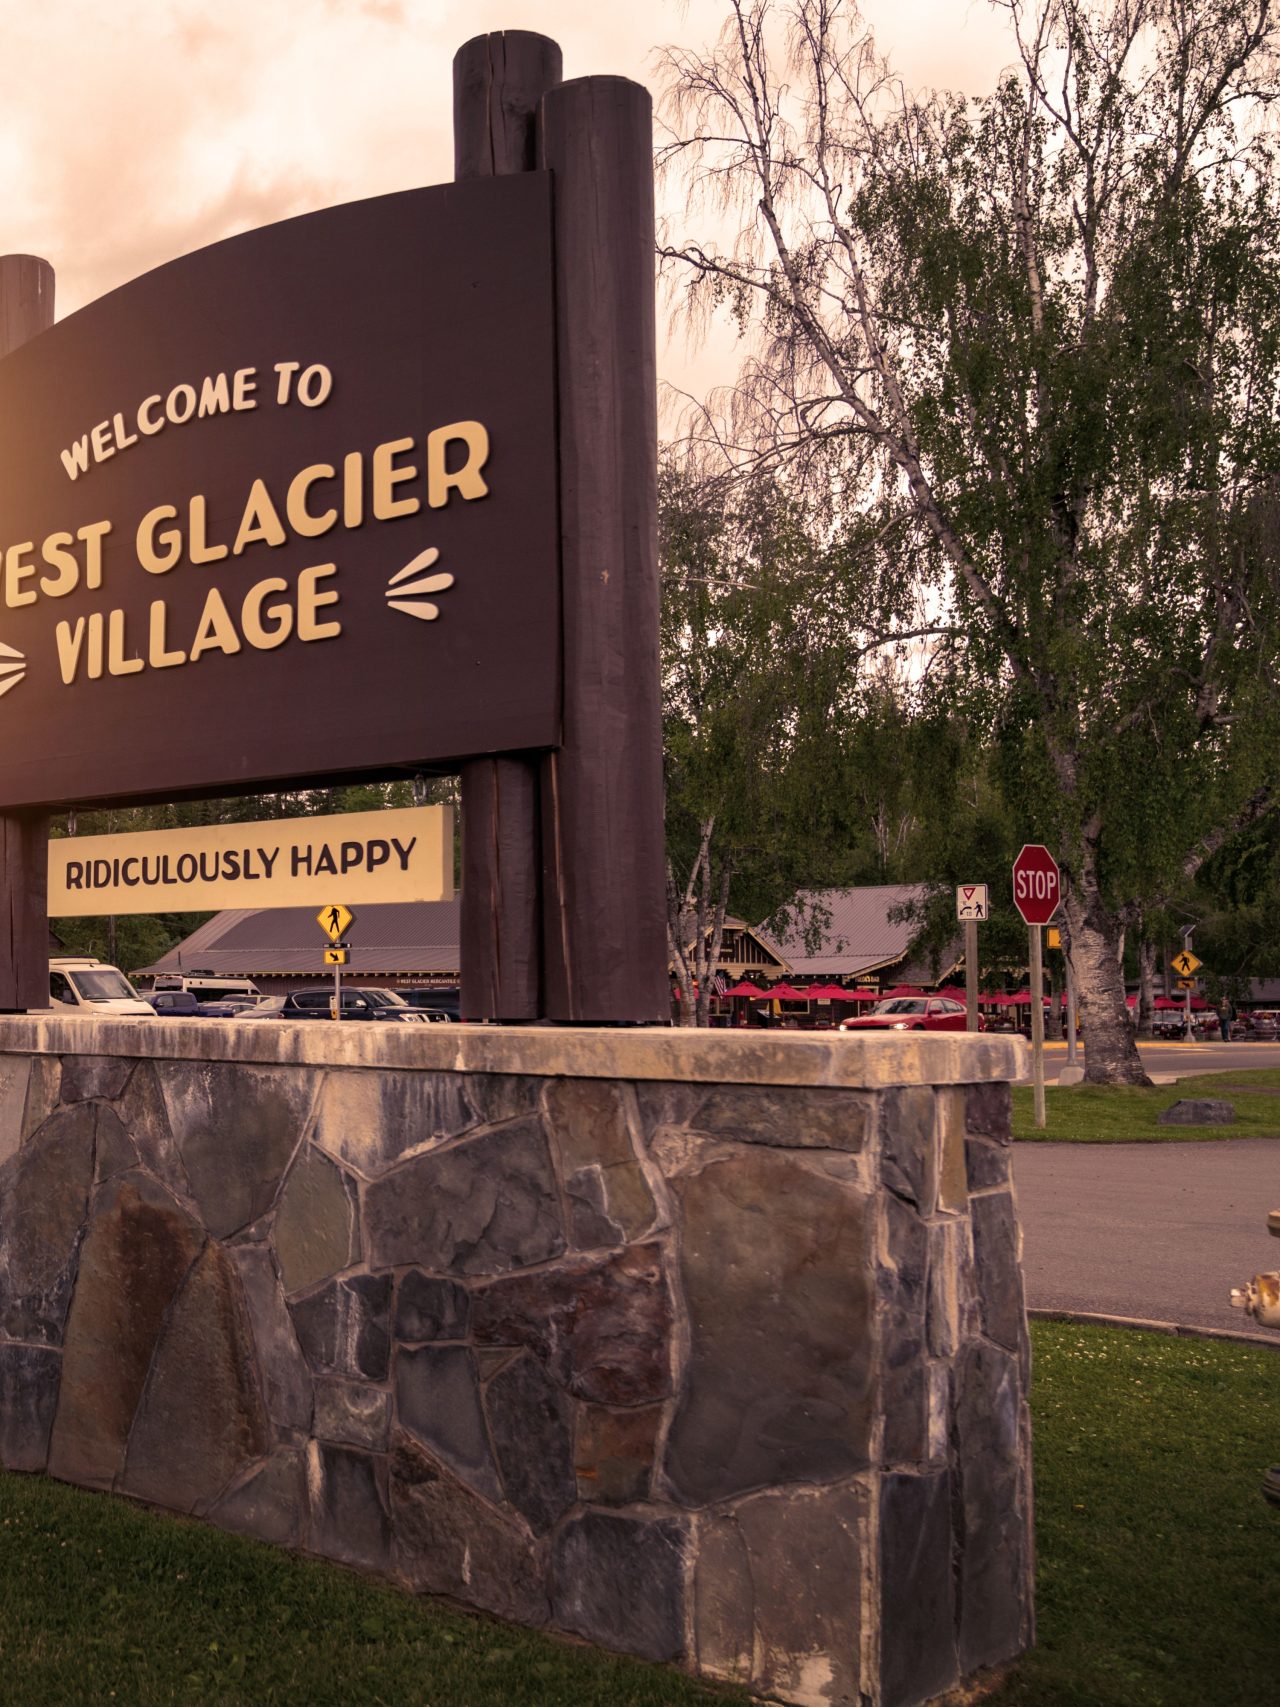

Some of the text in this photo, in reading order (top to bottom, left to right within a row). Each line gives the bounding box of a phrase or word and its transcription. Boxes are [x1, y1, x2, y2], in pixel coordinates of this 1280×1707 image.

[60, 362, 333, 481] WELCOME TO
[136, 420, 490, 574] GLACIER
[55, 563, 342, 684] VILLAGE
[66, 837, 417, 890] RIDICULOUSLY HAPPY
[1017, 870, 1057, 899] STOP
